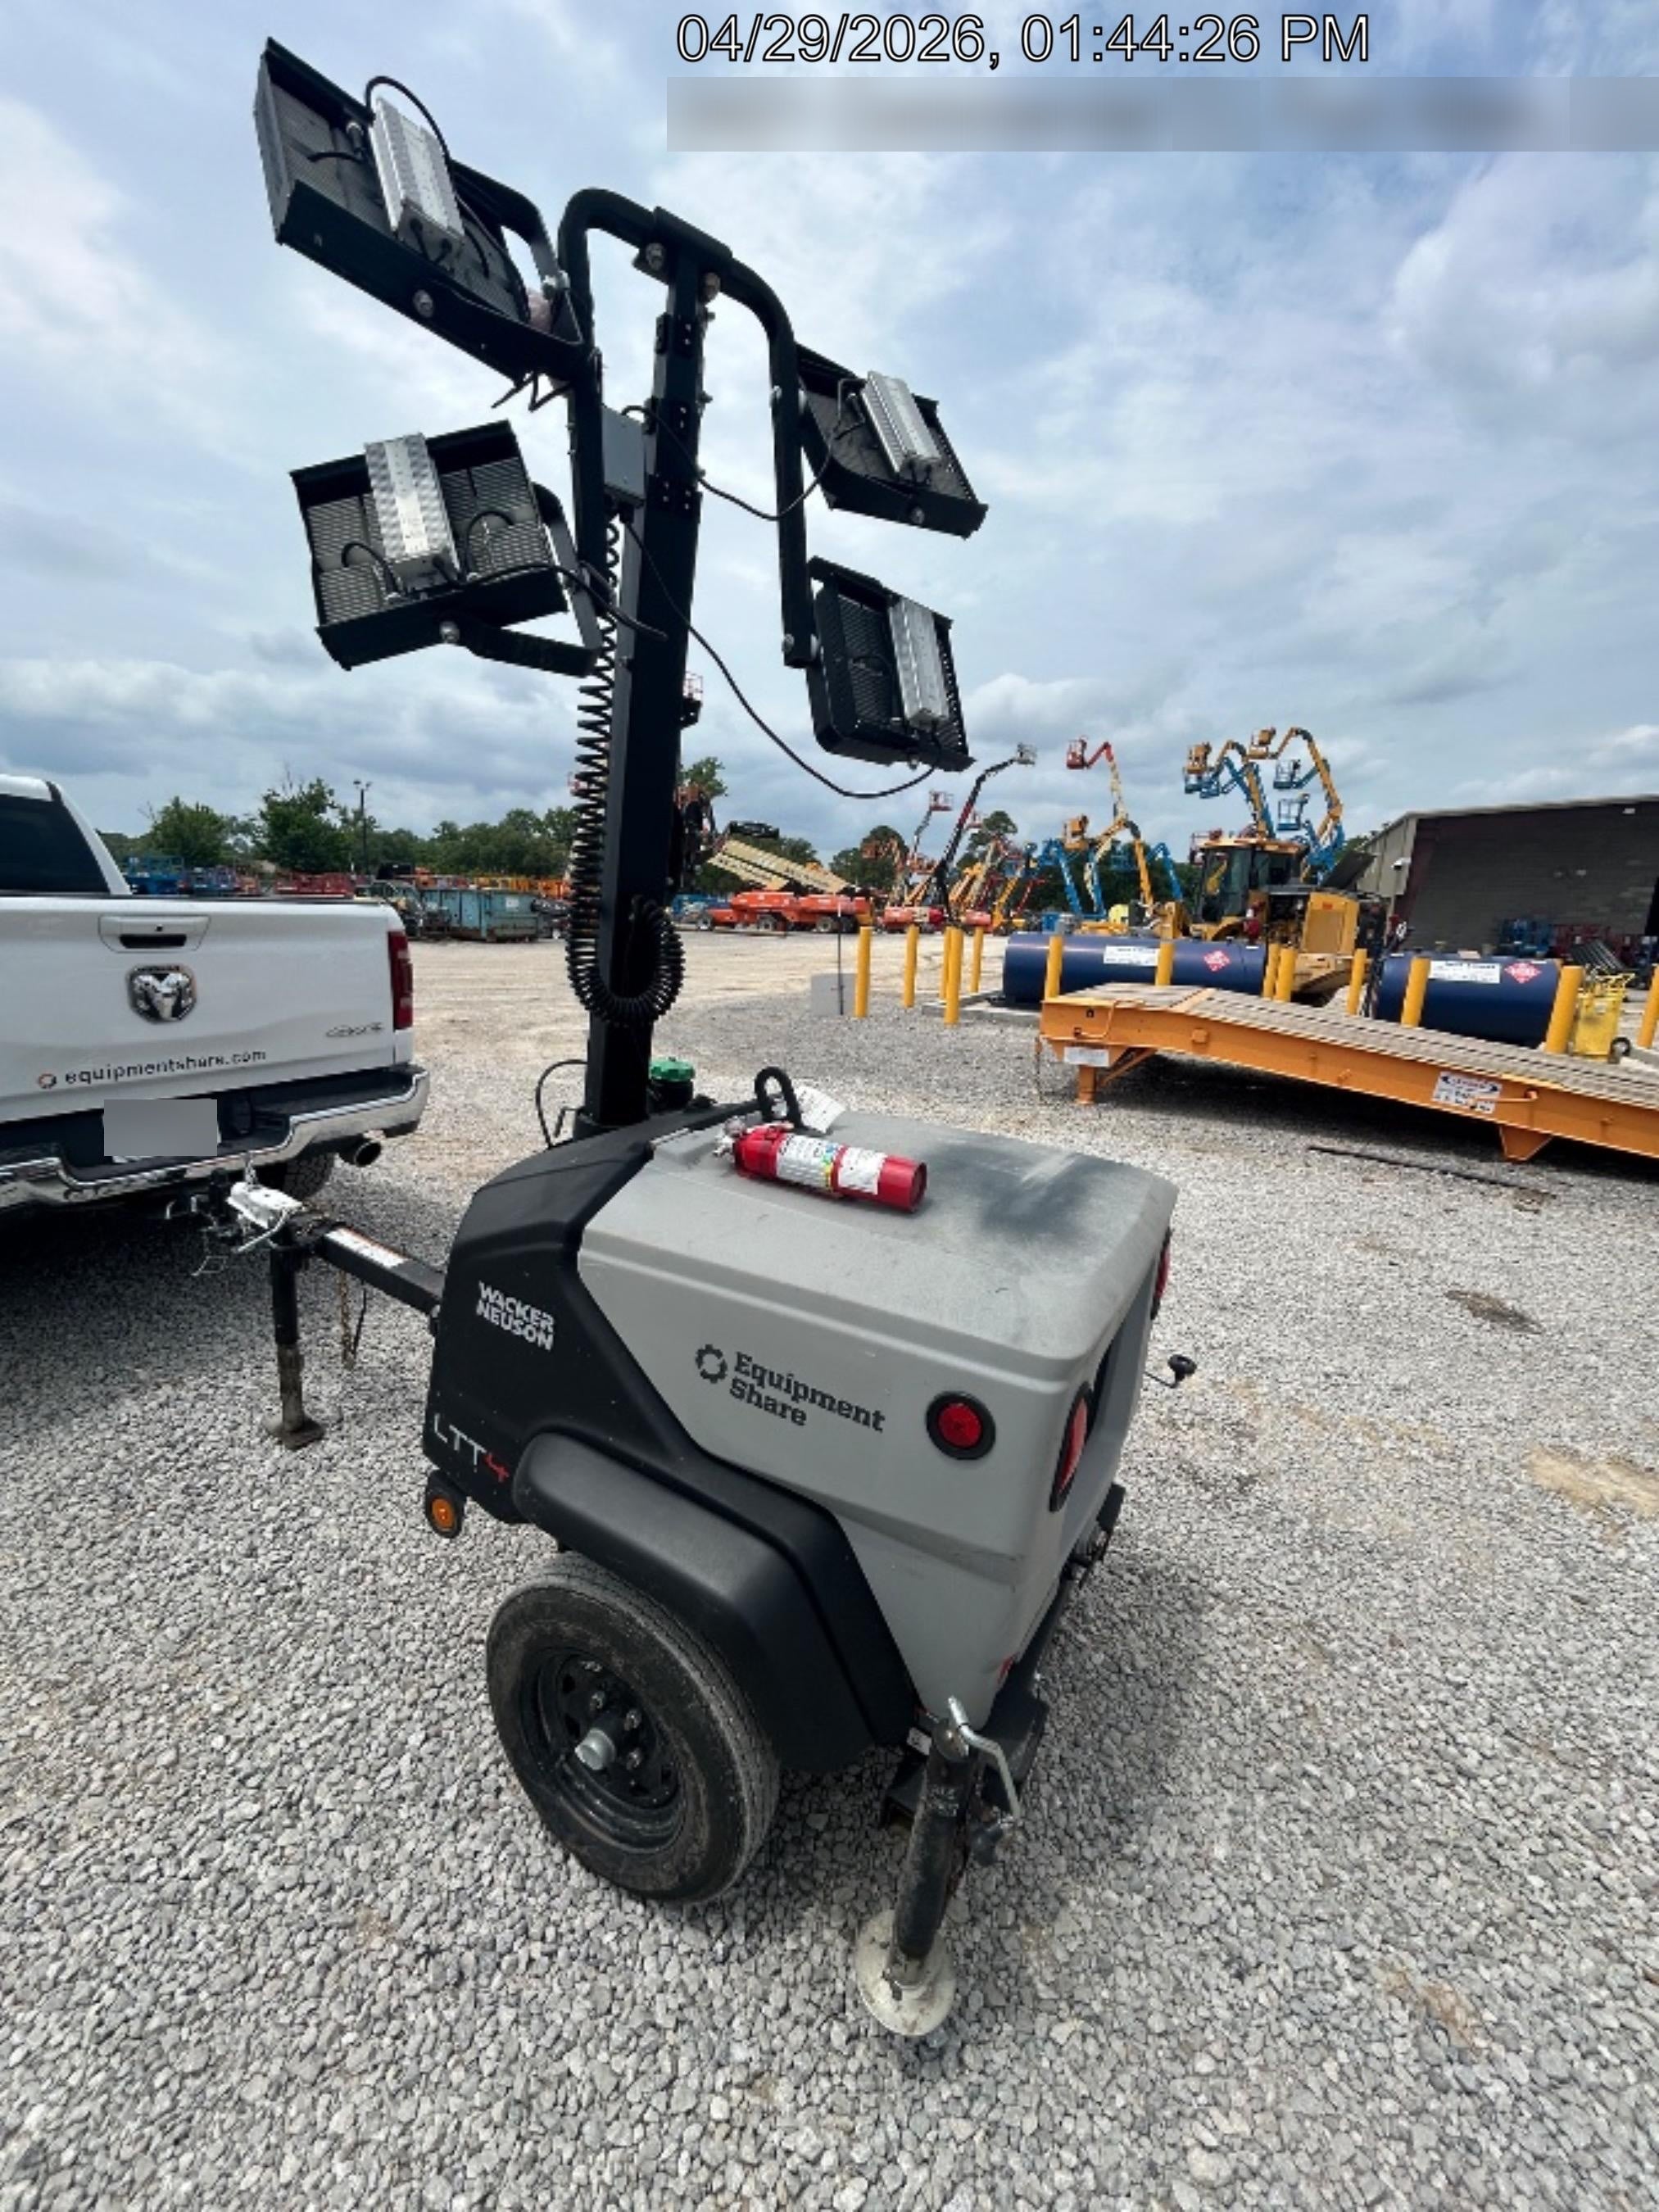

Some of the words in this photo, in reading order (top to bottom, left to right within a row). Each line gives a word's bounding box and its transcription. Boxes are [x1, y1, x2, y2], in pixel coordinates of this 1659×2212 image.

[66, 1049, 266, 1084] equipmentshare.com
[476, 1299, 554, 1351] NEUSON
[478, 1280, 555, 1333] WACKER
[729, 1376, 807, 1426] Share
[734, 1351, 886, 1434] Equipment
[433, 1412, 510, 1484] LTT4
